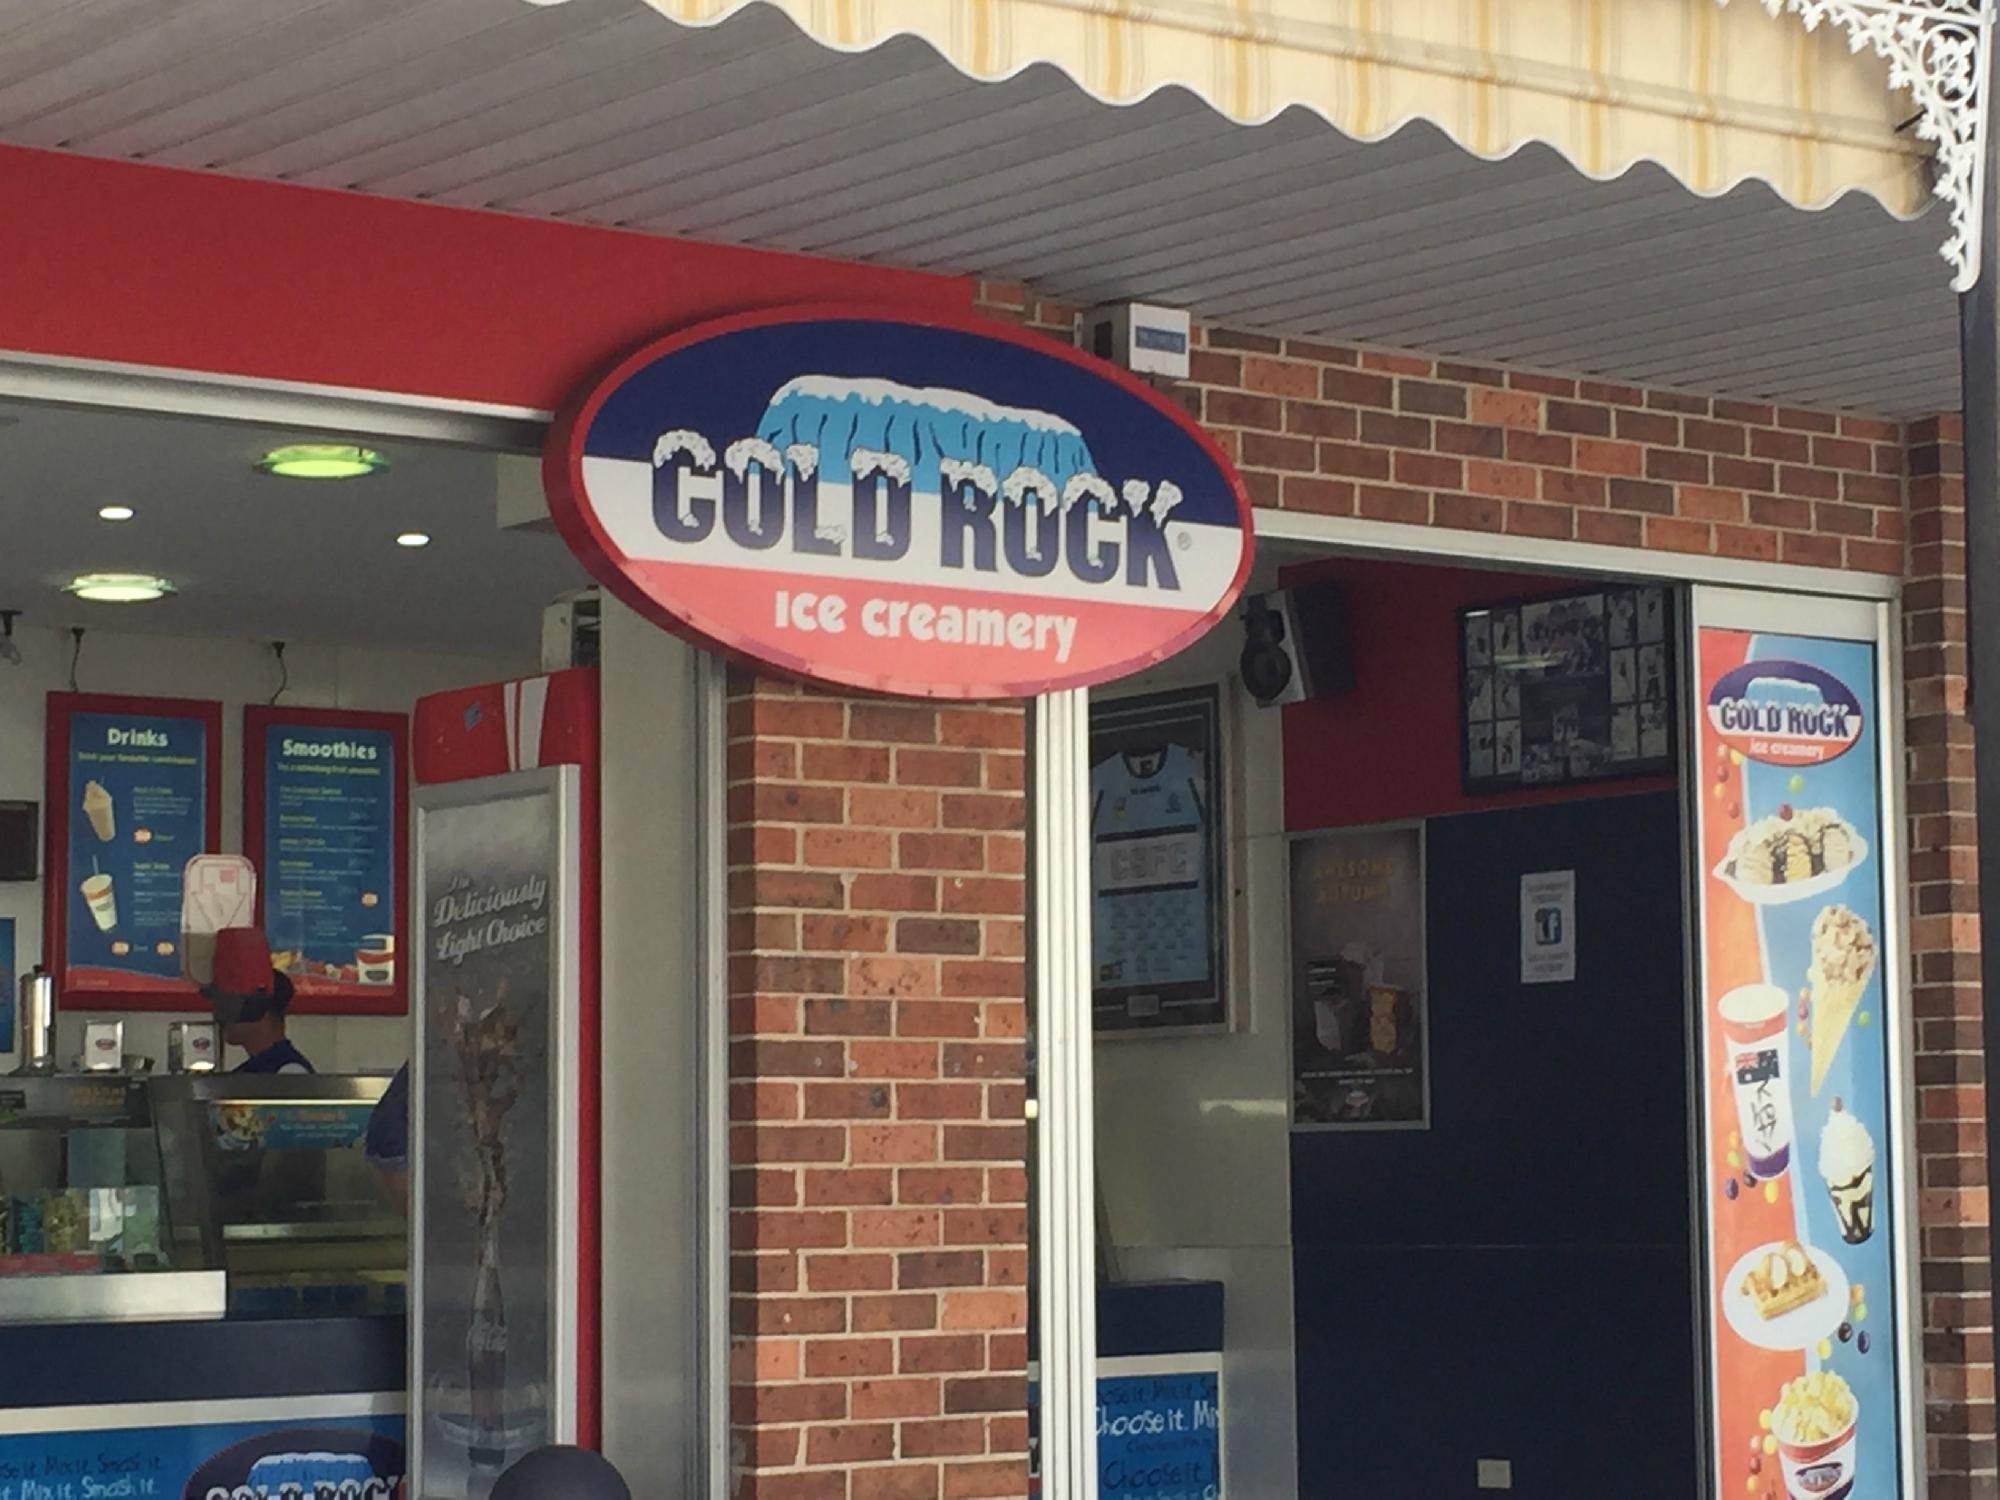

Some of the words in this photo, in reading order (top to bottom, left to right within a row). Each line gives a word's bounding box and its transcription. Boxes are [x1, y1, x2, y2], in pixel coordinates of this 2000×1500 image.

[651, 429, 911, 561] COLD
[940, 457, 1183, 590] ROCK
[861, 597, 1078, 664] creamery
[107, 727, 168, 748] Drinks
[1719, 697, 1781, 733] COLD
[1785, 702, 1850, 738] ROCK
[282, 738, 377, 760] Smoothies
[433, 875, 547, 928] Deliciously
[436, 928, 483, 966] Light
[486, 913, 547, 946] Choice
